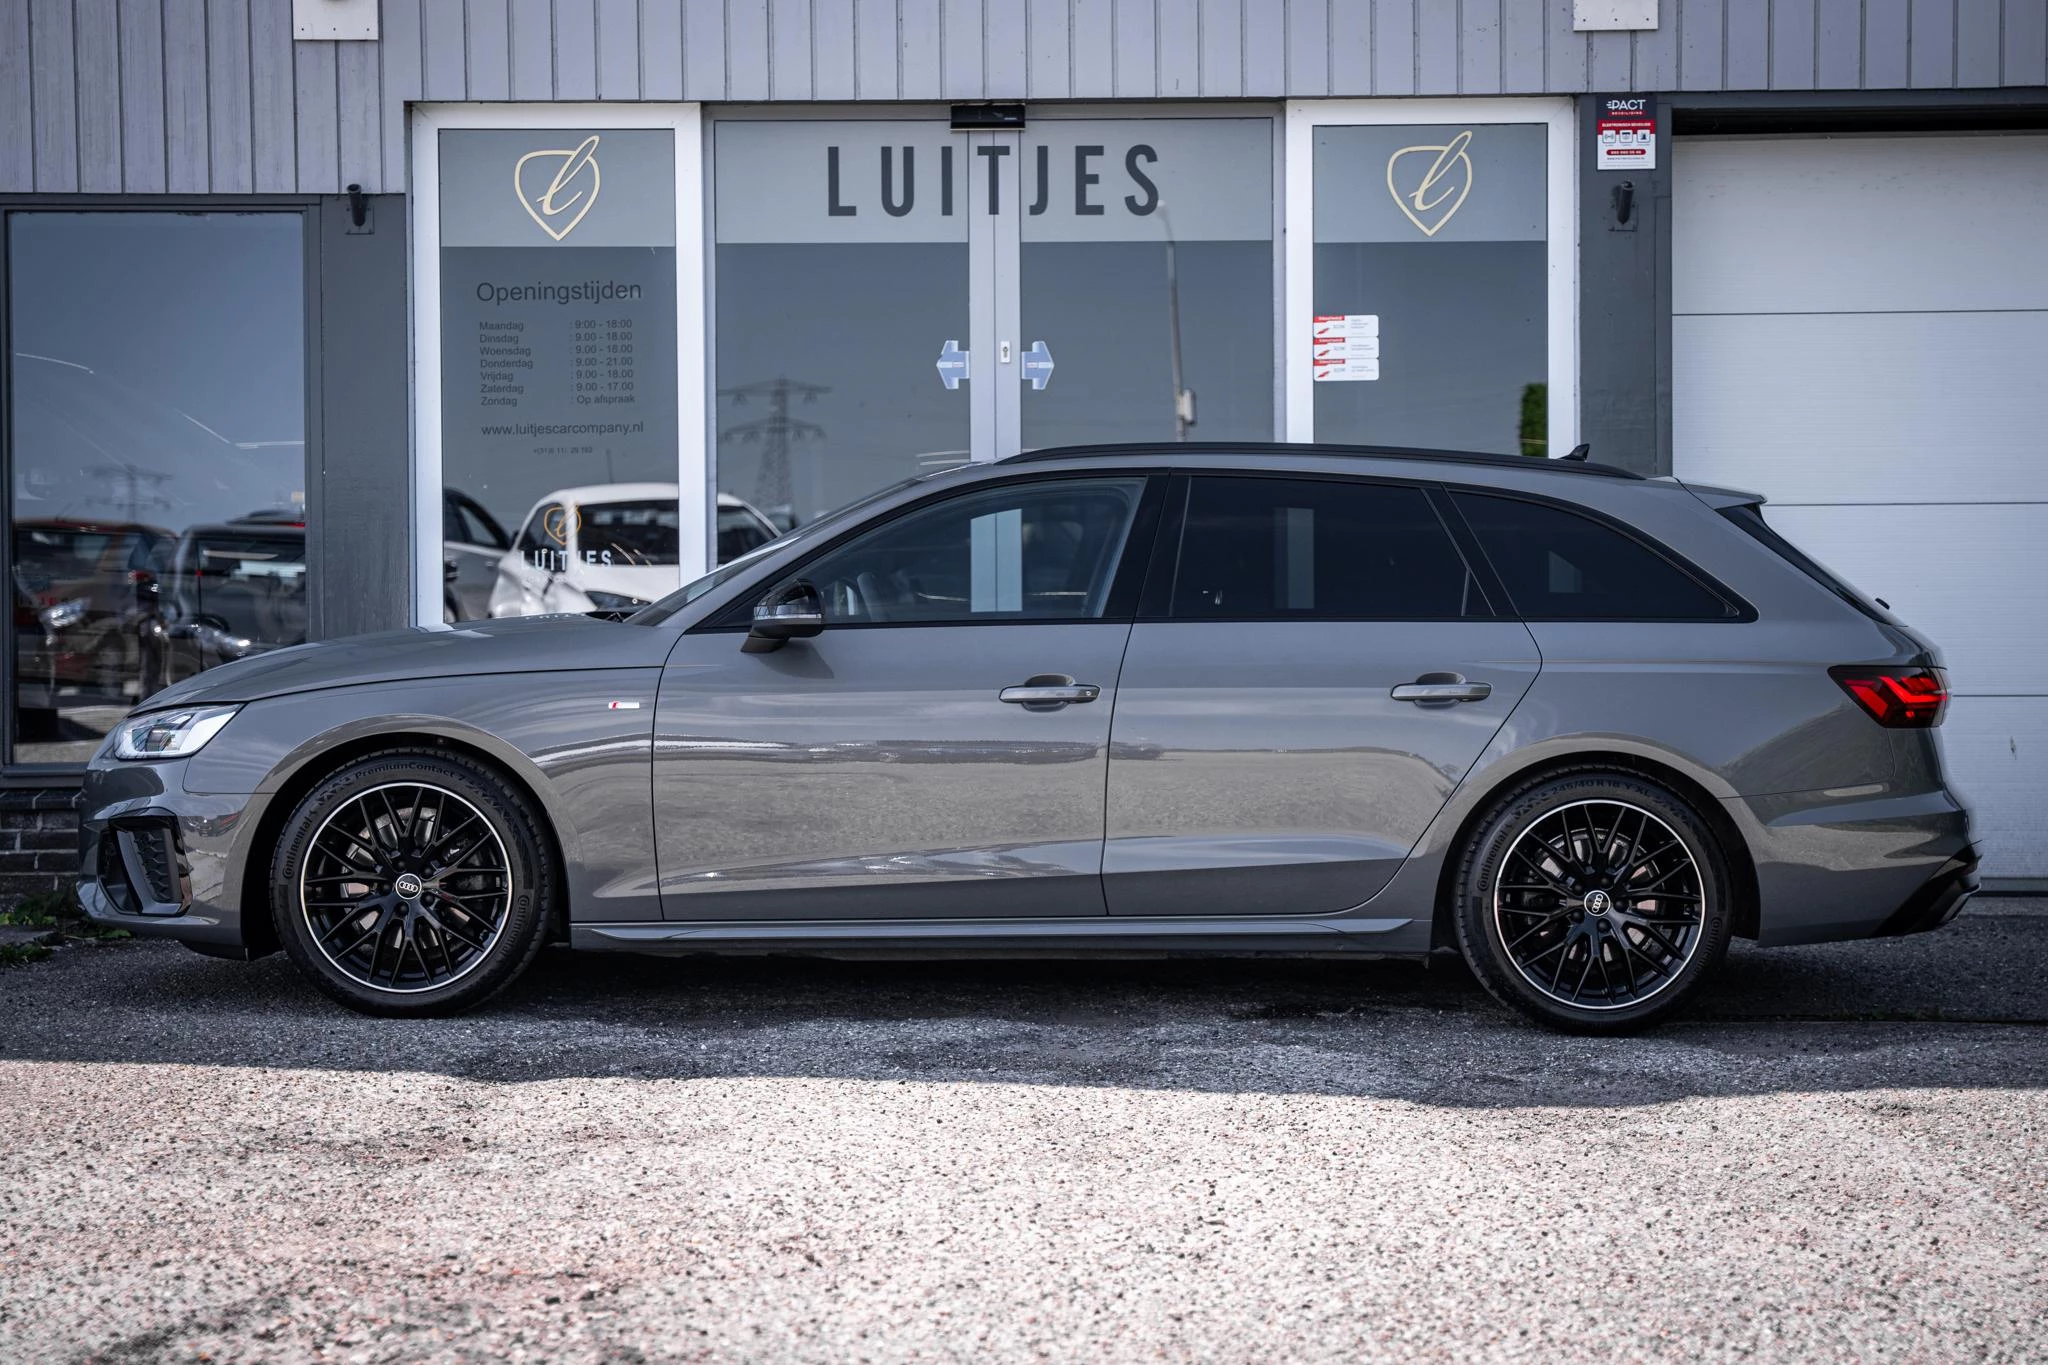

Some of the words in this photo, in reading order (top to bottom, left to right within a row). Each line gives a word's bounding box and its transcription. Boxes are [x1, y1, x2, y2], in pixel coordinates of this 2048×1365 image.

[828, 144, 1159, 217] LUITJES
[476, 281, 641, 306] Openingstijden
[479, 321, 524, 332] Maandag
[479, 334, 519, 344] Dinsdag
[480, 346, 531, 357] Woensdag
[480, 359, 533, 369] Donderdag
[480, 371, 513, 382] Vrijdag
[480, 384, 524, 395] Zaterdag
[480, 396, 517, 407] Zondag
[576, 394, 591, 405] Op
[594, 394, 635, 405] afspraak
[481, 421, 644, 437] www.luitjescarcompany.nl
[354, 761, 454, 779] PremiumContact
[1551, 780, 1594, 795] 245/40
[282, 816, 313, 879] Continental
[1477, 830, 1509, 891] Continental
